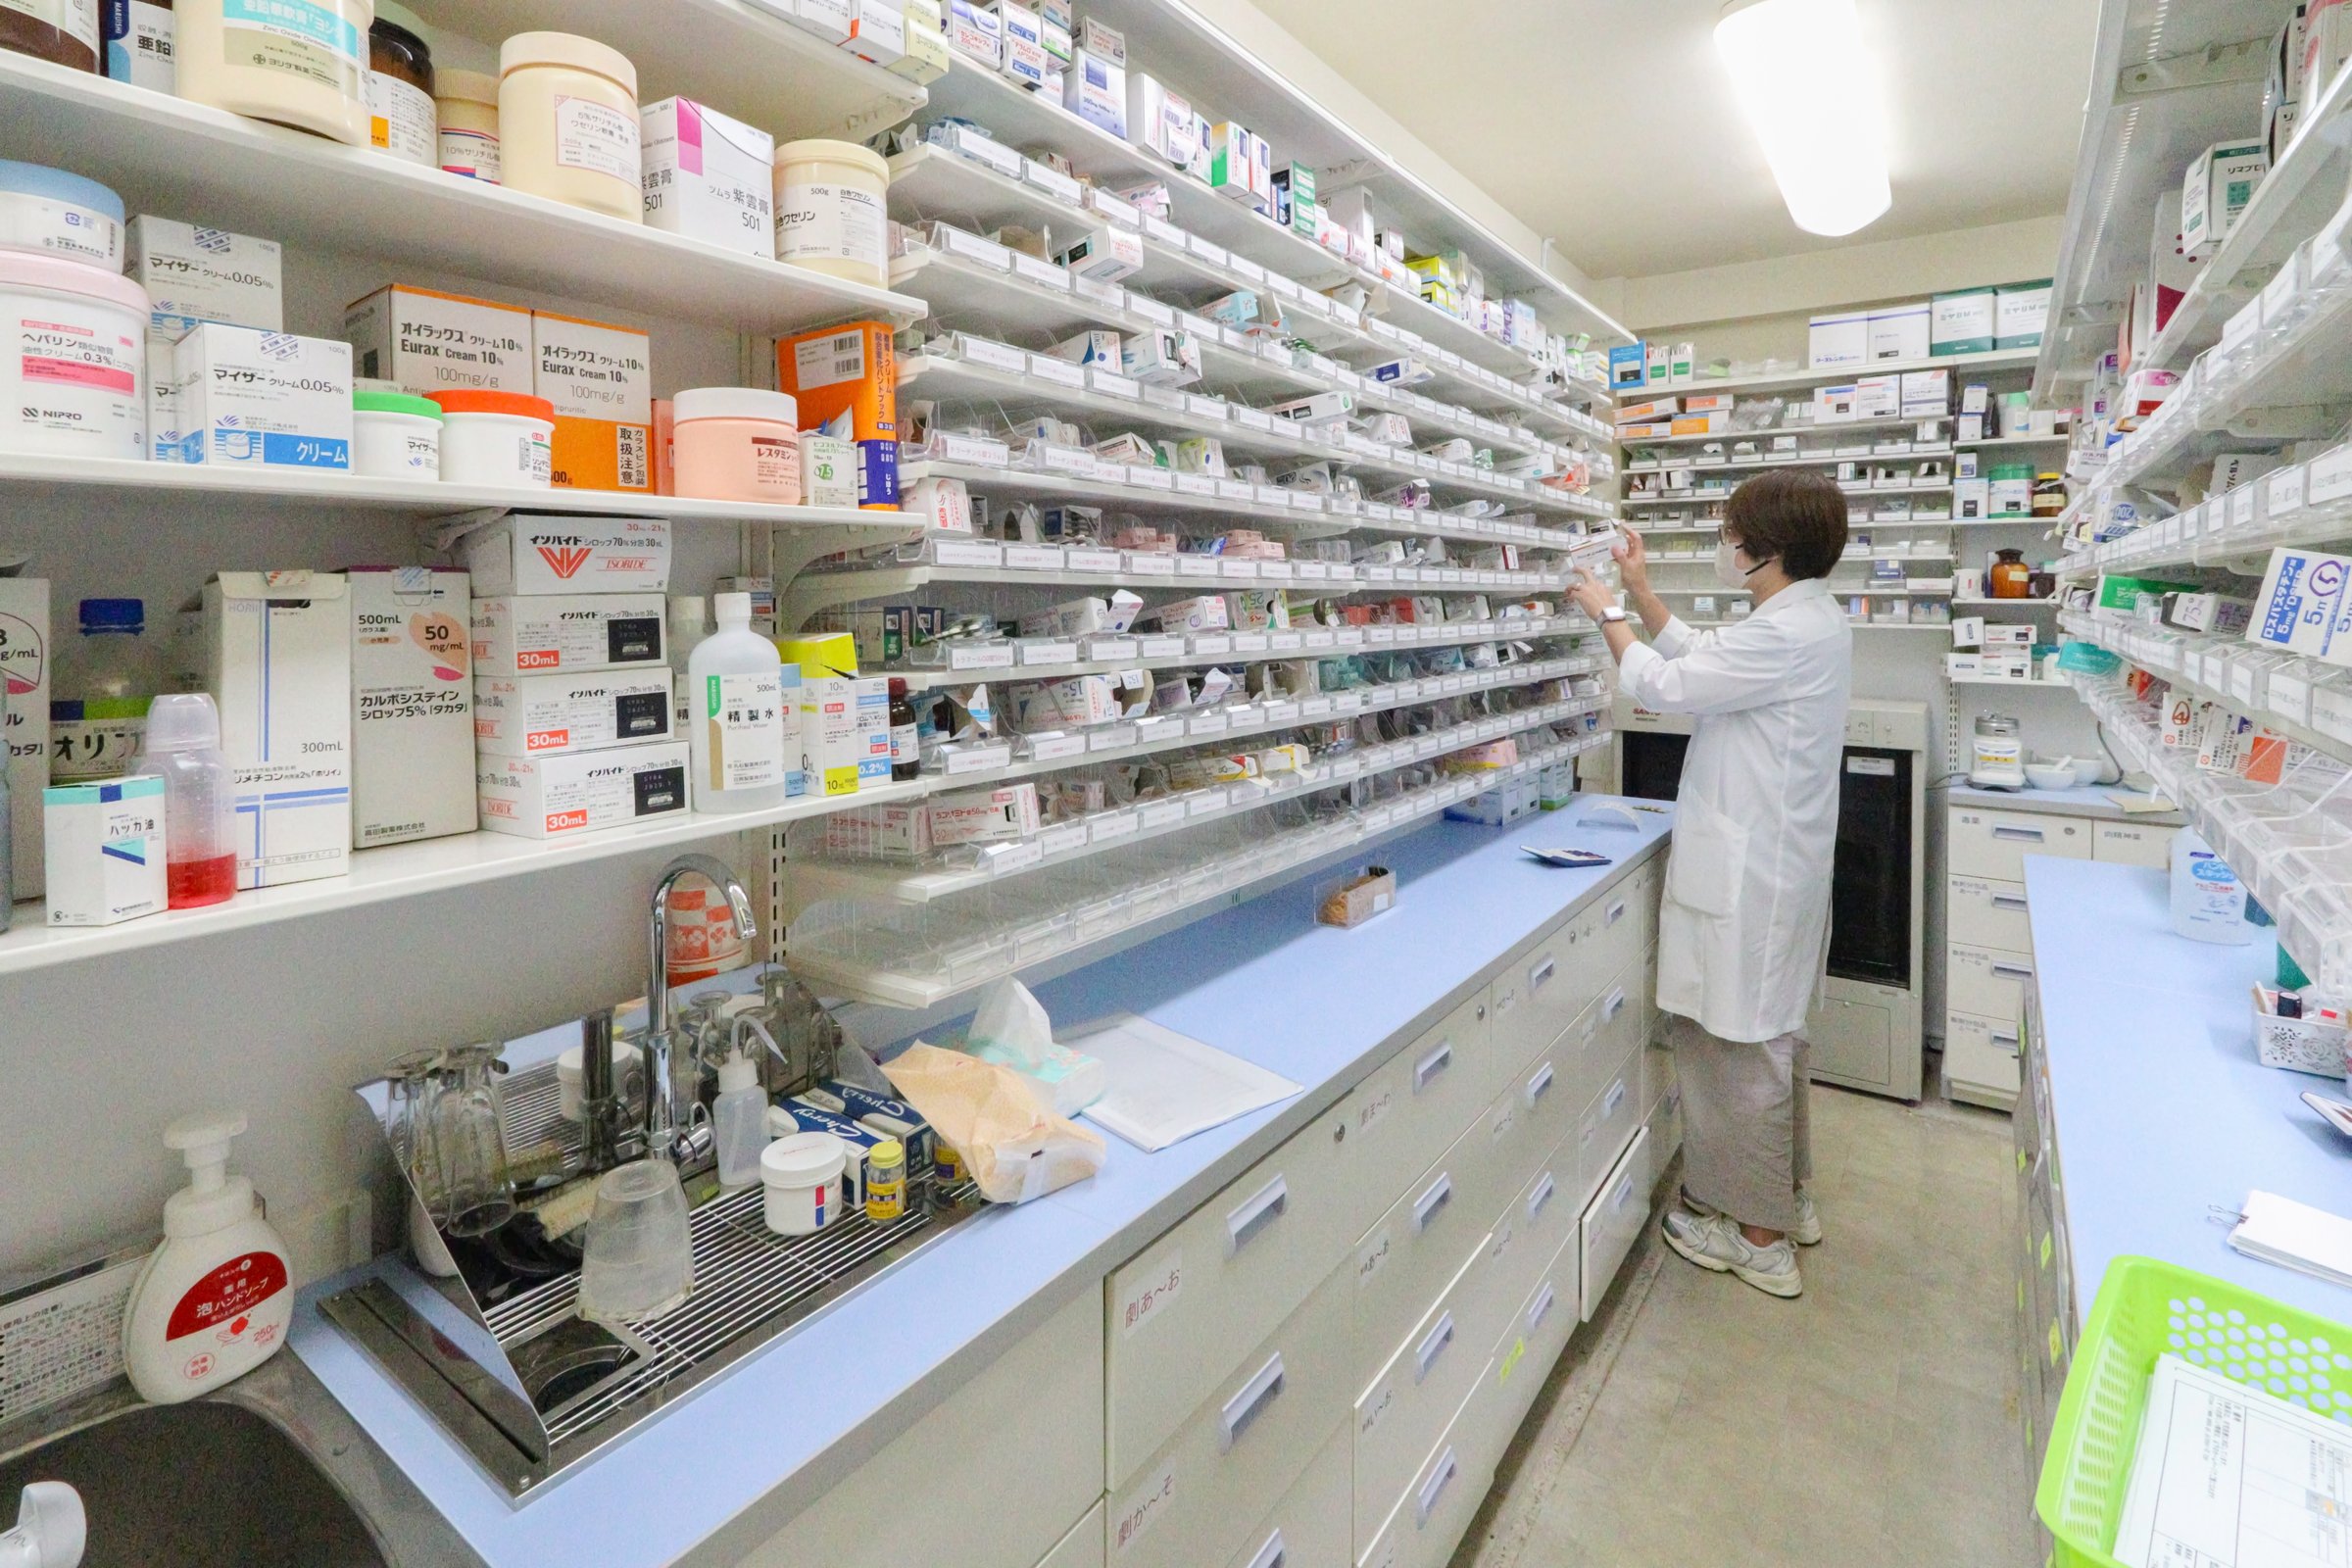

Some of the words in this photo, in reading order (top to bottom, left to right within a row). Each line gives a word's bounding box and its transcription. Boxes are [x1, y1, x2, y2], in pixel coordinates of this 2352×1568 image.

[137, 34, 174, 57] 亜鉛
[709, 184, 731, 201] ツムラ
[732, 187, 768, 216] 紫雲膏
[810, 187, 829, 196] 500g
[644, 193, 663, 212] 501
[742, 212, 760, 232] 501
[149, 256, 199, 273] マイザー
[202, 268, 274, 290] クリーム0.05%
[401, 321, 466, 343] オイラックス
[469, 334, 523, 353] クリーム10%
[401, 338, 440, 358] Eurax
[445, 346, 477, 363] Cream
[481, 350, 504, 366] 10%
[542, 344, 596, 364] オイラックス
[600, 355, 644, 371] クリーム10%
[433, 366, 499, 389] 100mg/g
[542, 360, 575, 376] Eurax
[579, 367, 607, 381] Cream
[610, 371, 628, 384] 10%
[213, 368, 267, 384] マイザー
[269, 376, 345, 396] クリーム0.05%
[570, 384, 625, 405] 100mg/g
[42, 410, 82, 421] NIPRO
[554, 403, 587, 415] tipruritic
[296, 441, 348, 465] クリーム
[619, 427, 635, 484] 取扱注意
[530, 535, 582, 546] イソバイド
[606, 559, 648, 569] ISOBIDE
[358, 614, 402, 625] 500mL
[560, 611, 598, 620] イソバイド
[424, 625, 449, 640] 50
[429, 641, 465, 653] mg/mL
[519, 653, 558, 666] 30mL
[568, 688, 607, 699] イソバイド
[757, 683, 777, 693] 500mL
[361, 690, 460, 708] カルボシステイン
[360, 706, 426, 721] シロップ5%
[429, 703, 468, 716] 「タカタ」
[727, 708, 774, 723] 精製水
[300, 741, 344, 755] 300mL
[528, 732, 566, 748] 30mL
[587, 766, 624, 778] イソバイド
[858, 762, 886, 775] 0.2%
[110, 818, 155, 837] ハッカ油
[547, 811, 586, 829] 30mL
[842, 1087, 905, 1117] Cherry
[793, 1107, 862, 1137] Cherry
